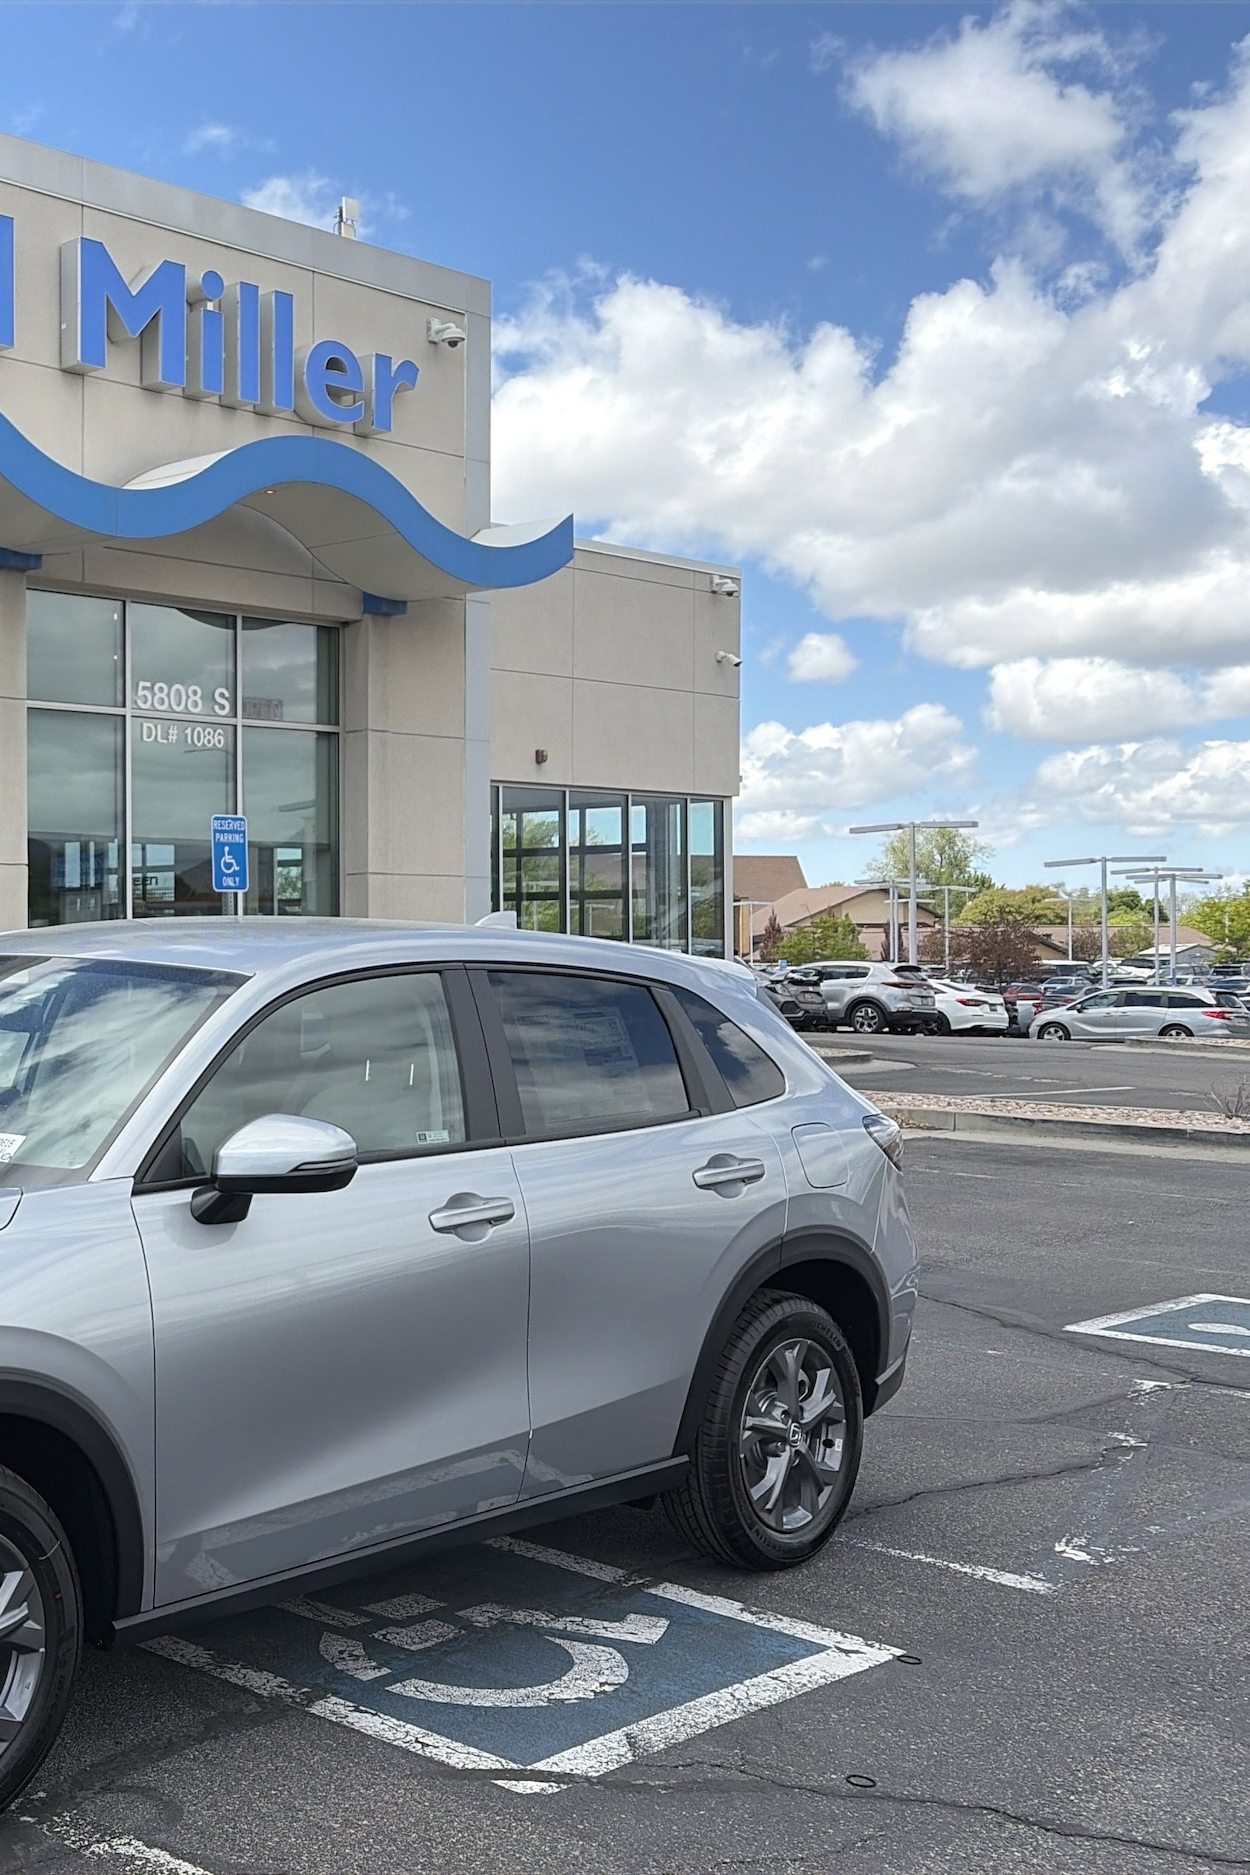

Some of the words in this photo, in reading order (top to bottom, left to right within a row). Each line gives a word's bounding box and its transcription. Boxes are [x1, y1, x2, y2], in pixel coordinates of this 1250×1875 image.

[61, 235, 419, 437] Miller
[136, 681, 202, 713] 5808
[213, 687, 230, 715] S
[142, 722, 178, 743] DL#
[185, 726, 224, 748] 1086
[213, 819, 245, 831] RESERVED
[215, 832, 244, 843] PARKING
[222, 876, 240, 887] ONLY
